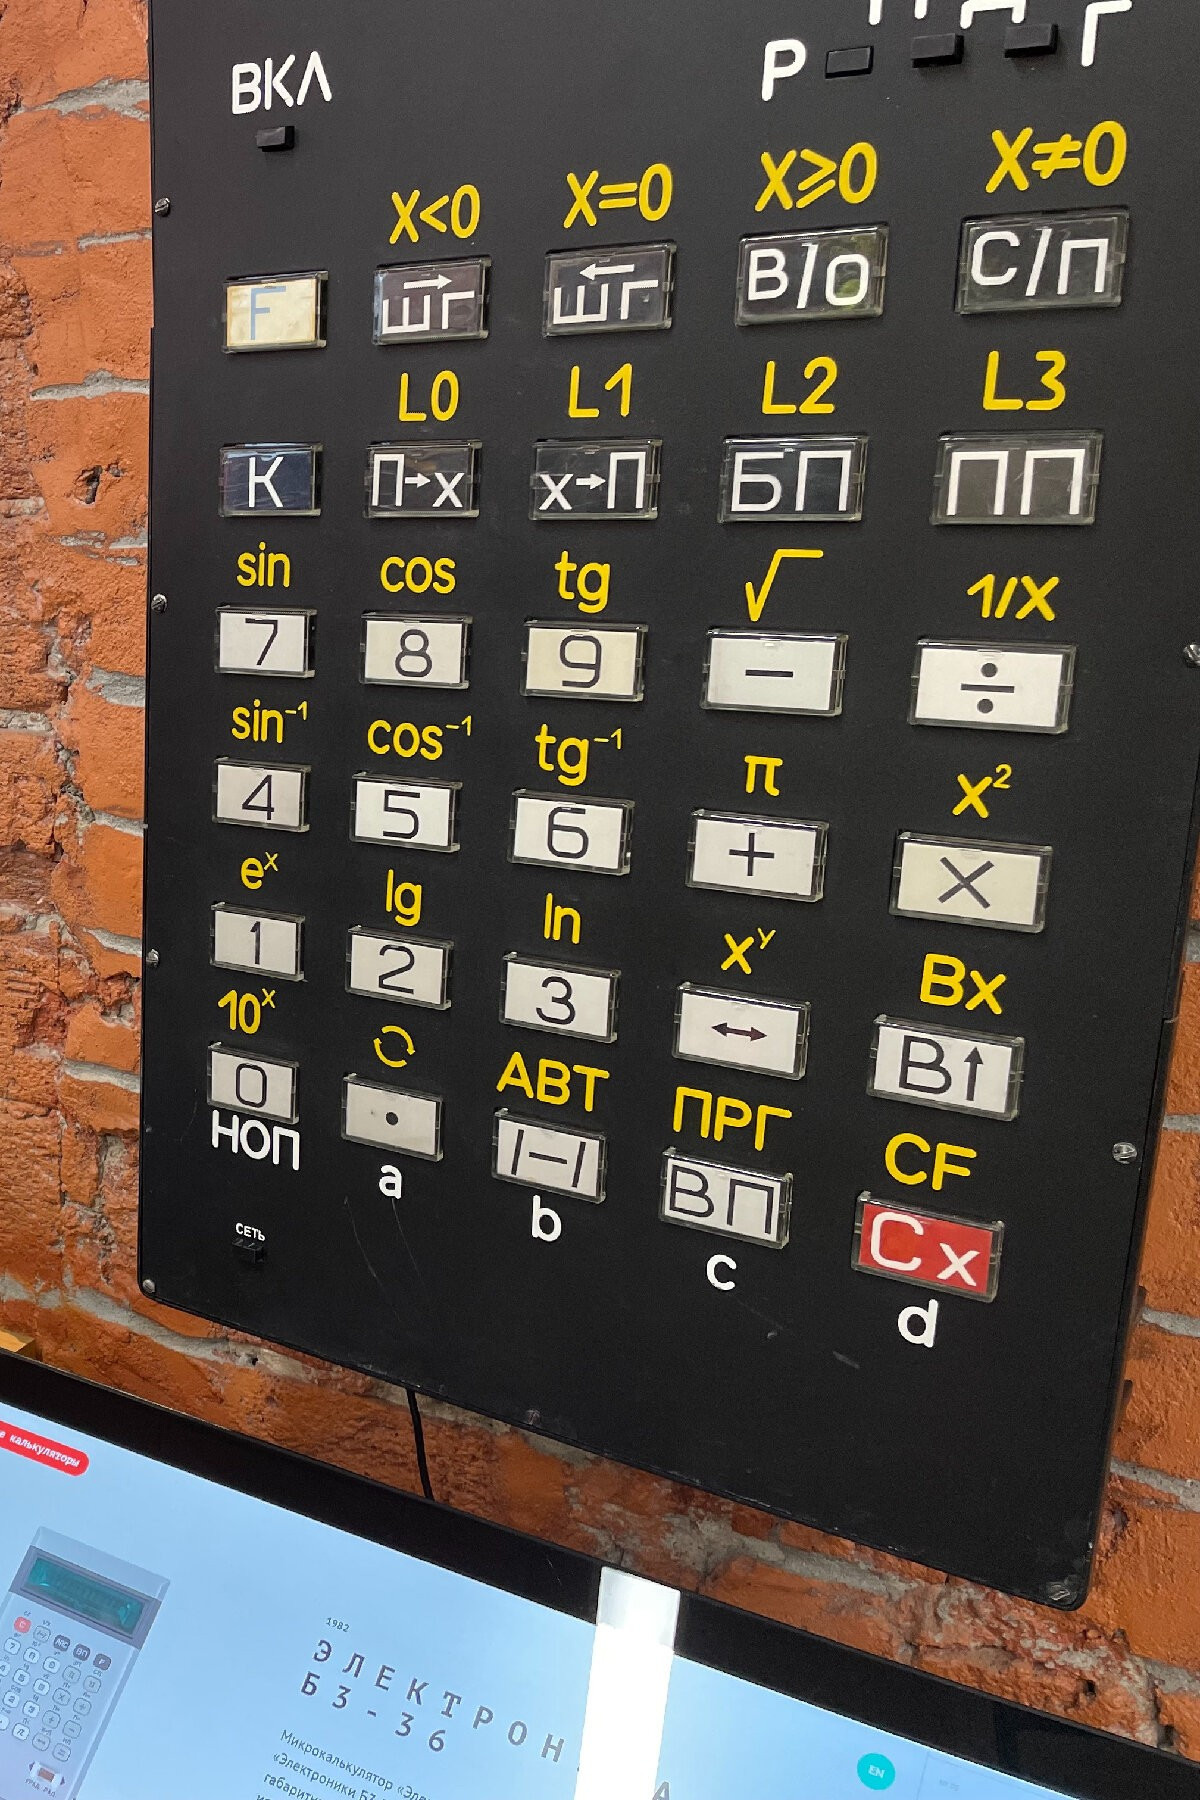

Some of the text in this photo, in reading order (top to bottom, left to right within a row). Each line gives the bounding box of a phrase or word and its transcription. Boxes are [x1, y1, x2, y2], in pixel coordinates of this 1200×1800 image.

[232, 50, 332, 115] ВКЛ
[249, 286, 287, 341] F
[567, 363, 634, 418] L1
[762, 356, 838, 414] L2
[982, 350, 1067, 411] L3
[730, 450, 852, 513] БП
[945, 448, 1086, 516] ПП
[235, 541, 291, 588] sin
[379, 556, 457, 595] cos
[554, 550, 611, 614] tg
[244, 618, 279, 667] 7
[394, 628, 434, 679] 8
[559, 634, 603, 689] 9
[241, 774, 275, 822] 4
[382, 789, 422, 840] 5
[547, 805, 589, 859] 6
[385, 869, 423, 927] lg
[543, 892, 582, 945] ln
[249, 920, 262, 966] 1
[377, 944, 416, 995] 2
[535, 975, 576, 1026] 3
[495, 1050, 610, 1112] АВТ
[211, 1109, 301, 1171] НОП
[671, 1085, 793, 1152] ПРГ
[378, 1163, 403, 1200] a
[669, 1163, 775, 1235] ВП
[235, 1221, 266, 1242] СЕТЬ
[531, 1194, 563, 1243] b
[897, 1298, 939, 1349] d
[9, 1434, 81, 1468] калькуляторы
[325, 1616, 351, 1634] 1982
[312, 1638, 670, 1800] ЭЛЕКТРОНА
[280, 1729, 394, 1793] Микрокалькулятор
[867, 1764, 886, 1779] EN
